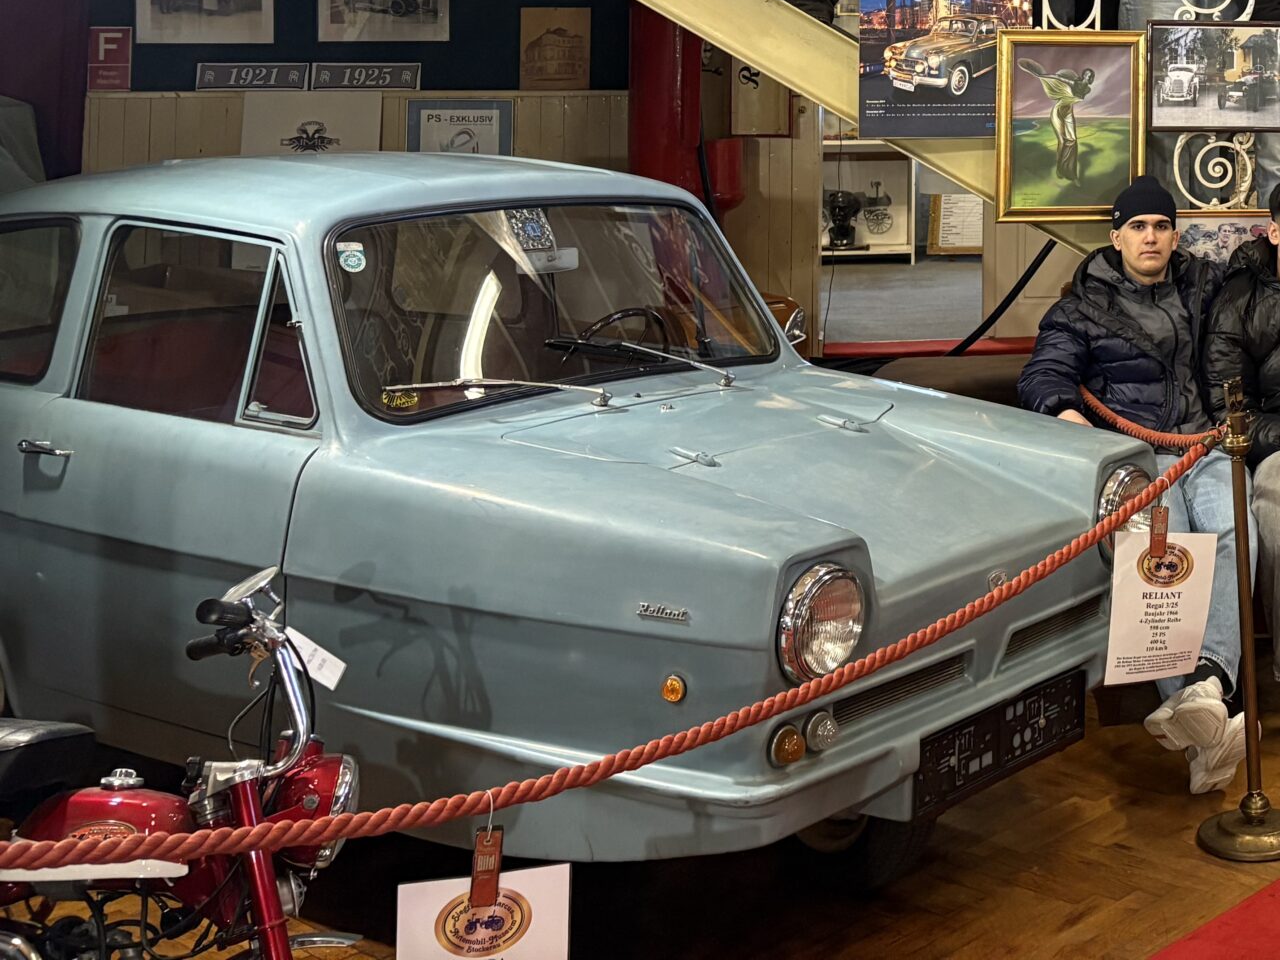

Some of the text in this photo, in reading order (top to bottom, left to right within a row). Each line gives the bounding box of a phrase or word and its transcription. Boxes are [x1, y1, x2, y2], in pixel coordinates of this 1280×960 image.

[98, 32, 123, 61] F
[227, 67, 279, 86] 1921
[341, 68, 393, 86] 1925
[427, 114, 441, 123] PS
[449, 115, 493, 123] EXKLUSIV
[1142, 591, 1183, 600] RELIANT
[636, 602, 689, 620] Reliant
